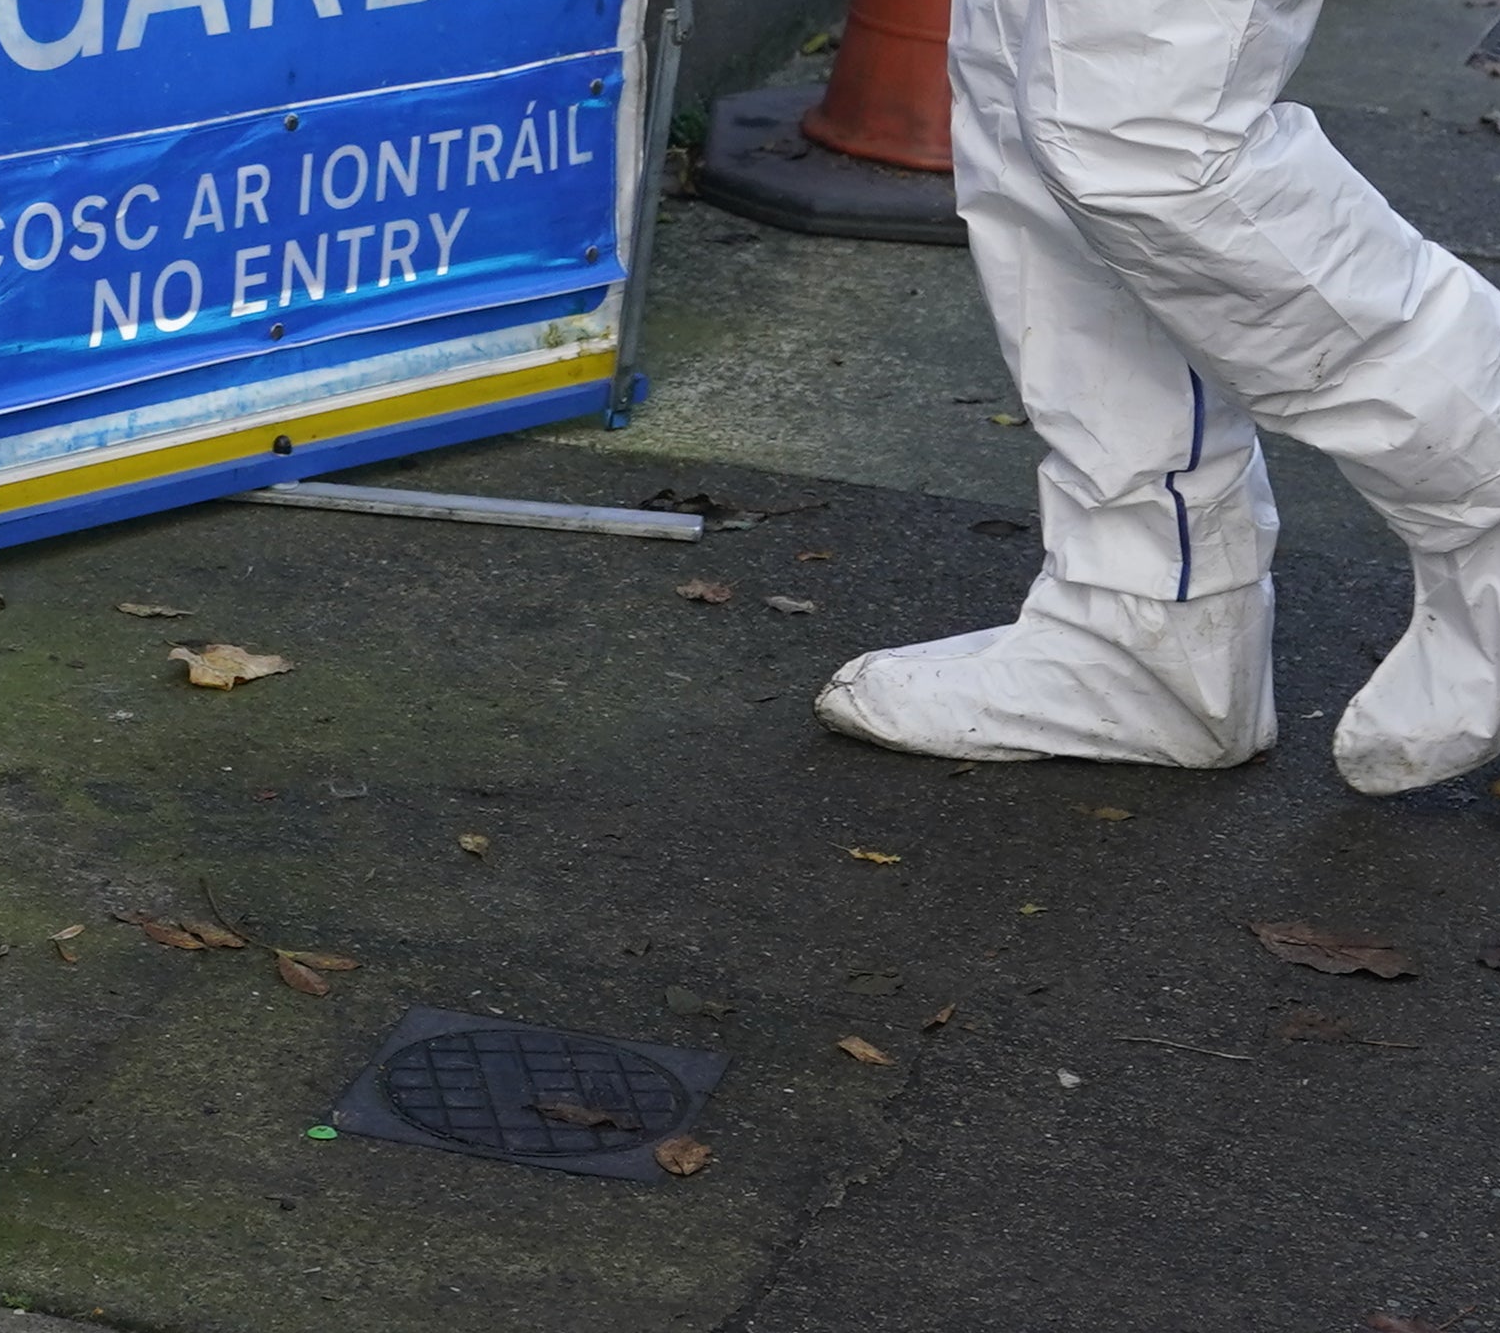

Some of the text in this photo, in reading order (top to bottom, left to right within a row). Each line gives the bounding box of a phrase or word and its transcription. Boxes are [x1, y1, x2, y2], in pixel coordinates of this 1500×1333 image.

[184, 162, 270, 241] AR
[299, 101, 594, 215] IONTRÁIL
[89, 208, 472, 349] NO ENTRY
